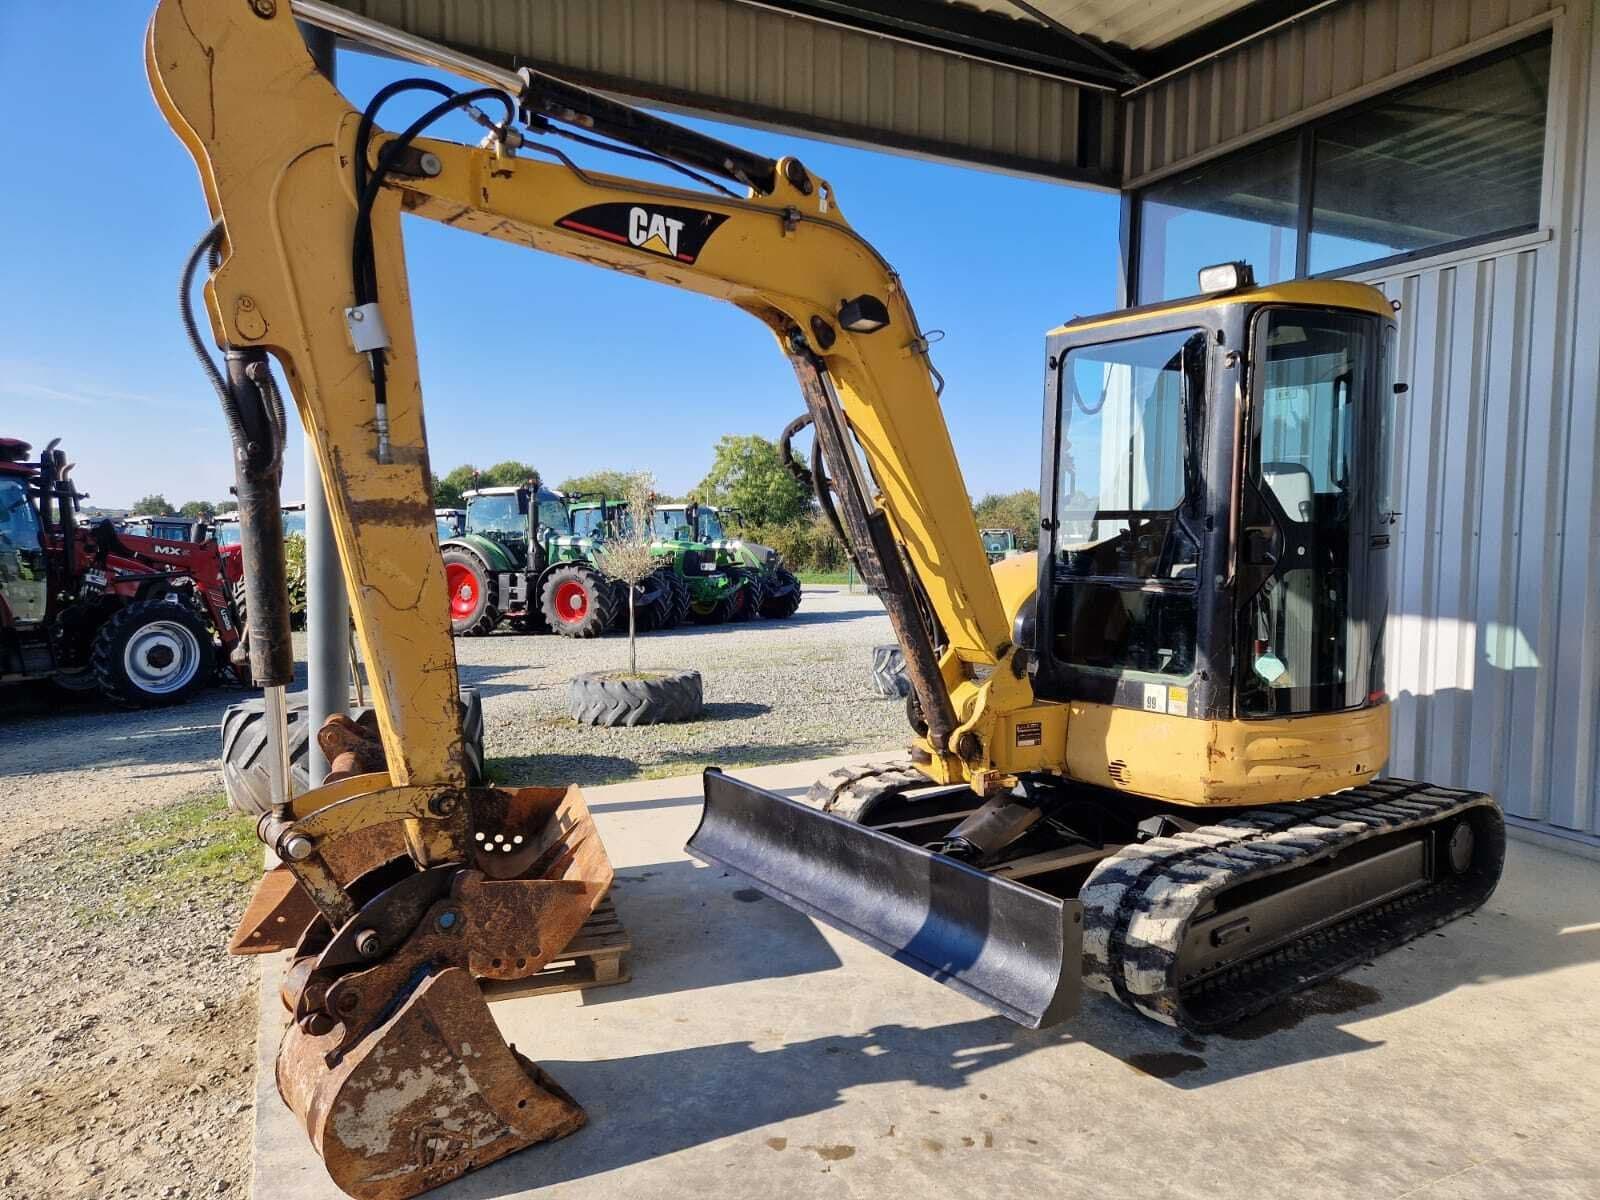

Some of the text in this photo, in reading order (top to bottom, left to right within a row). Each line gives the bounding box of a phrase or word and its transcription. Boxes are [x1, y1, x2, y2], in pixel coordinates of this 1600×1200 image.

[628, 206, 686, 257] CAT
[154, 545, 181, 556] MX
[1146, 695, 1157, 710] 99
